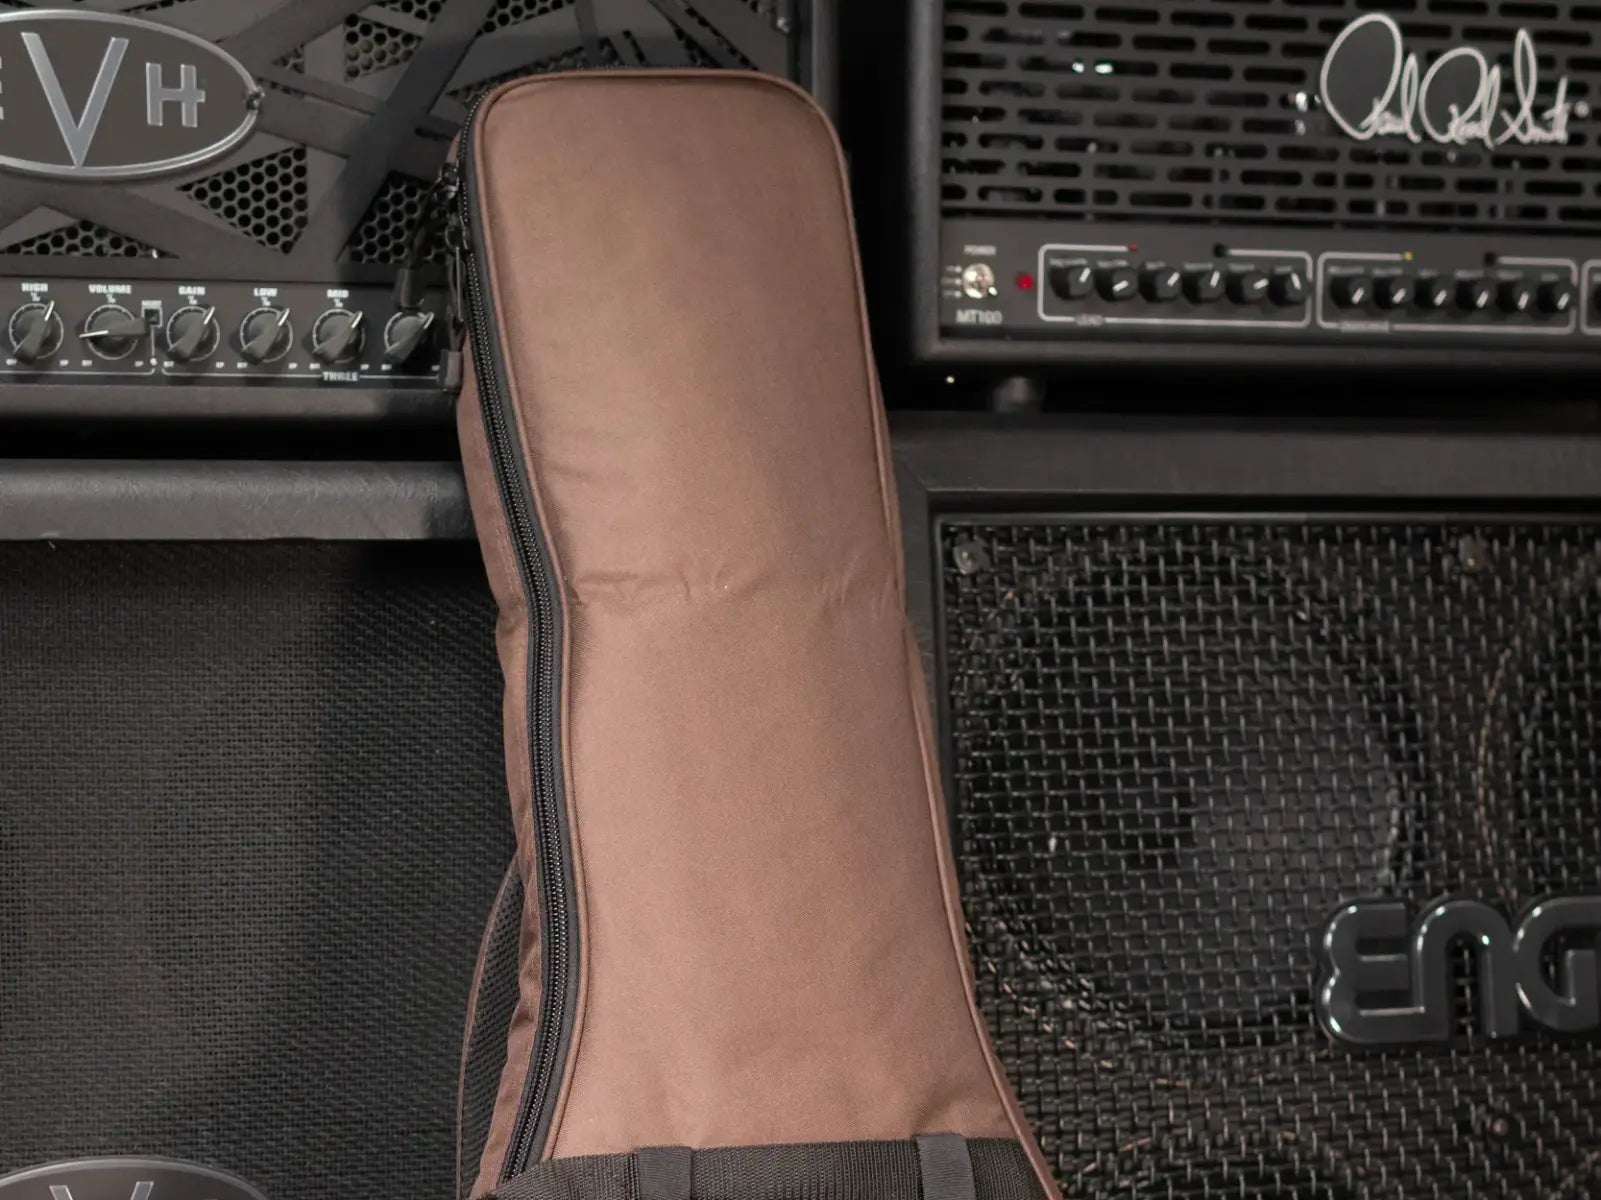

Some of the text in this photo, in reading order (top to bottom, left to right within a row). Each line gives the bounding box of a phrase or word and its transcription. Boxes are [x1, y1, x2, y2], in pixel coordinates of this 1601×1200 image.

[0, 32, 206, 170] VH
[88, 284, 132, 295] VOLUME
[178, 286, 206, 296] GAIN
[253, 288, 278, 297] LOW
